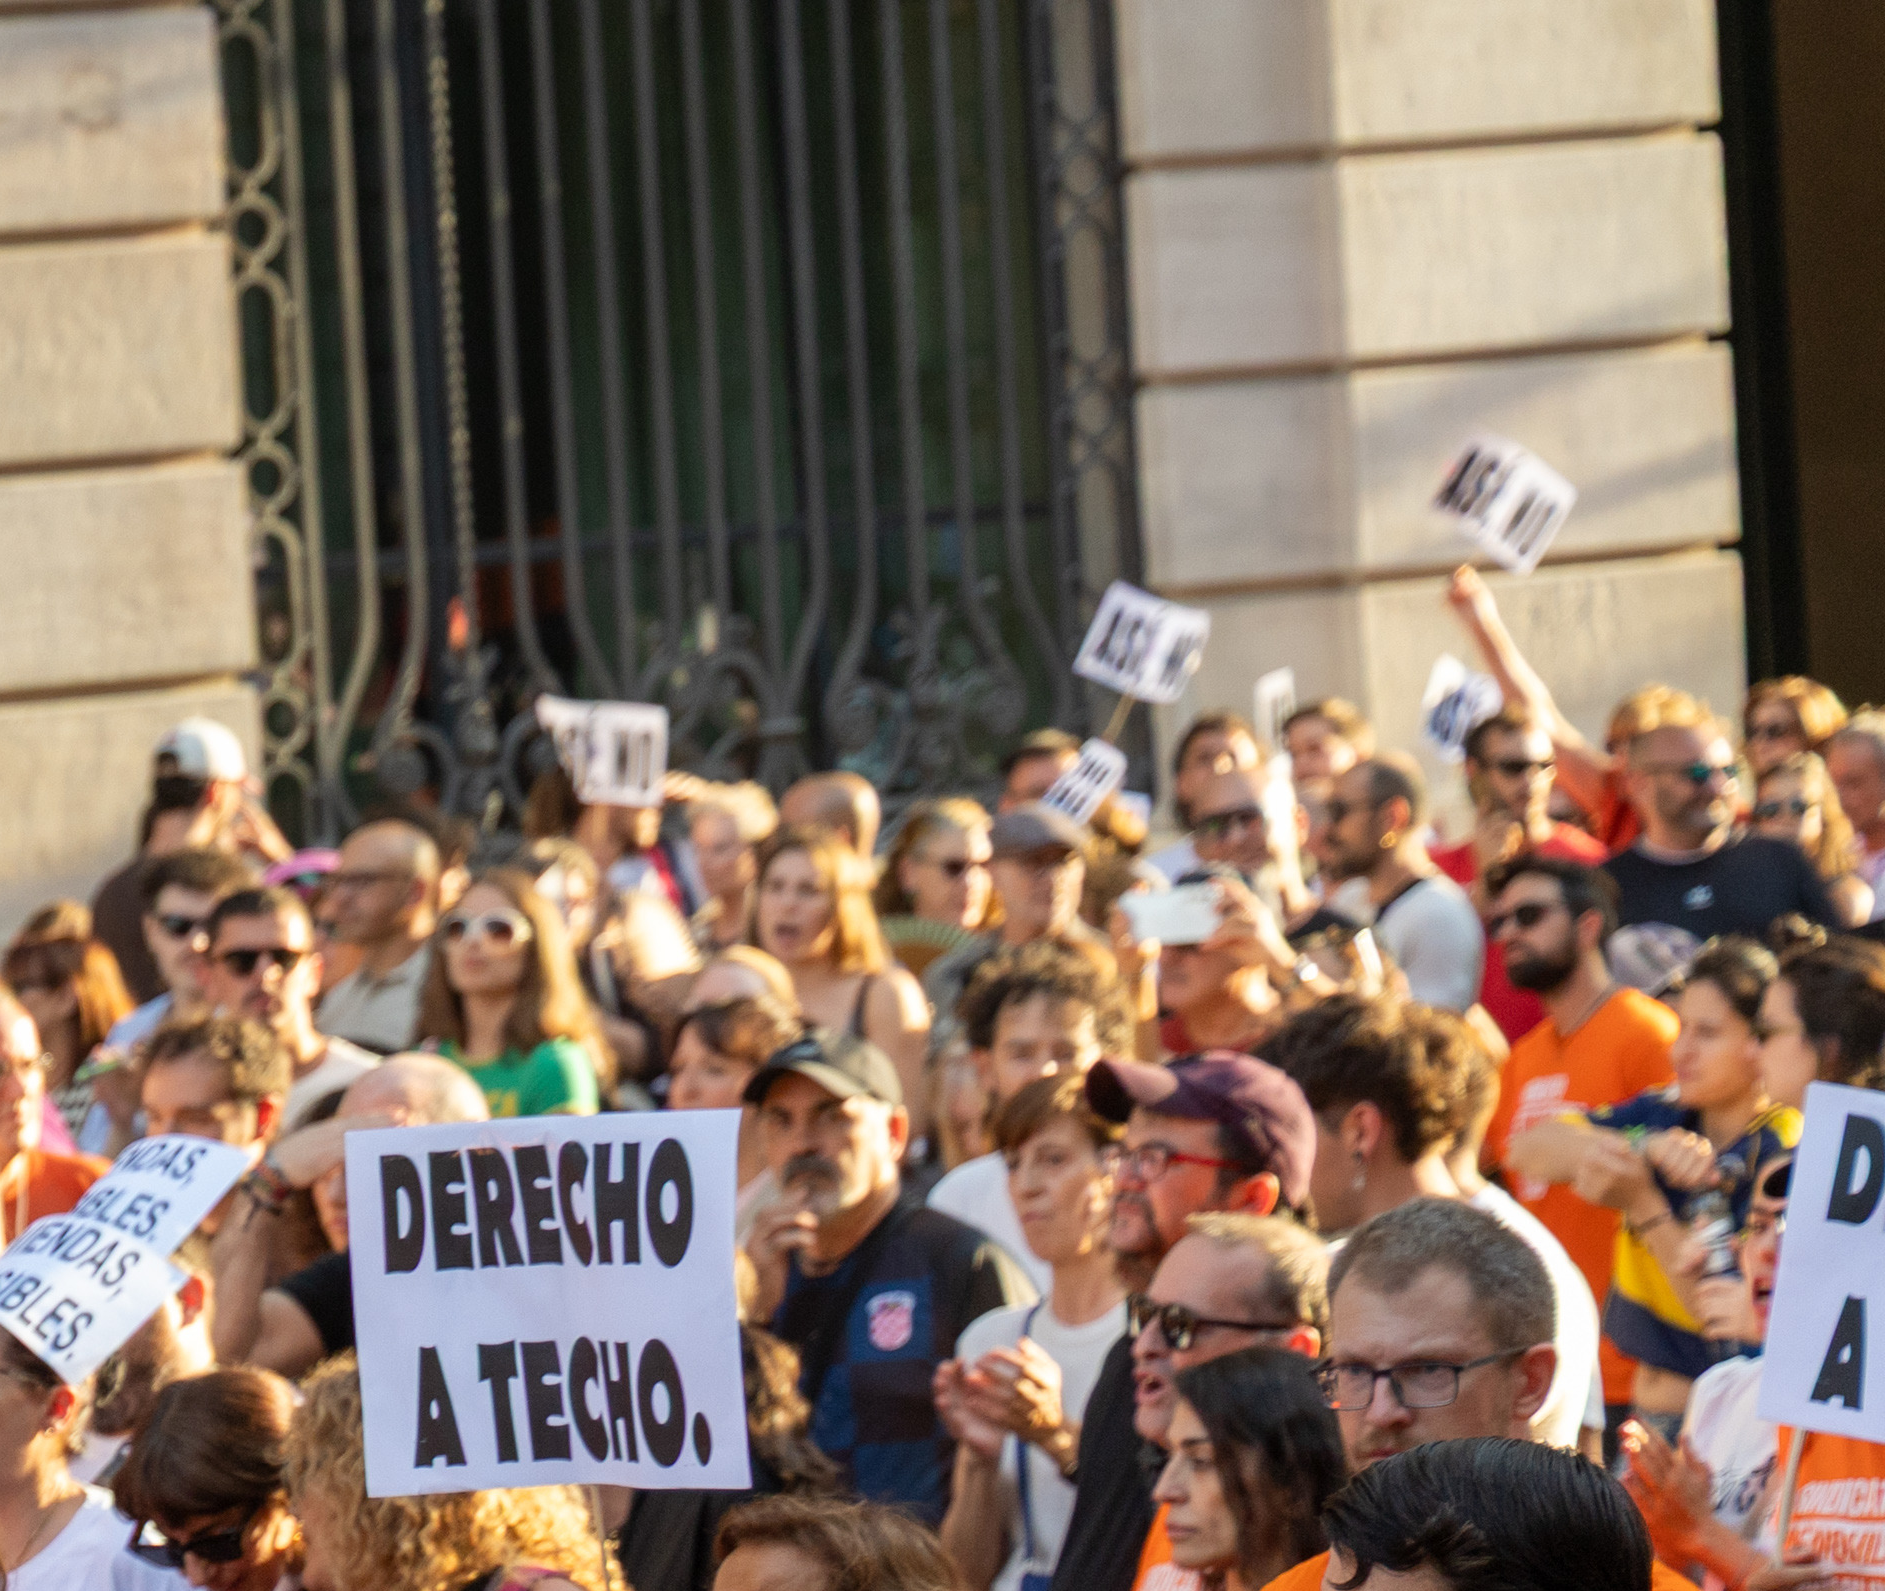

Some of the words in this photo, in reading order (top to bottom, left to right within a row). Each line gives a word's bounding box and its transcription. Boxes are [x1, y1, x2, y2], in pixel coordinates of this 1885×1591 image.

[380, 1138, 694, 1275] DERECHO
[414, 1345, 468, 1468] A
[477, 1336, 712, 1468] TECHO.
[1810, 1294, 1867, 1412] A
